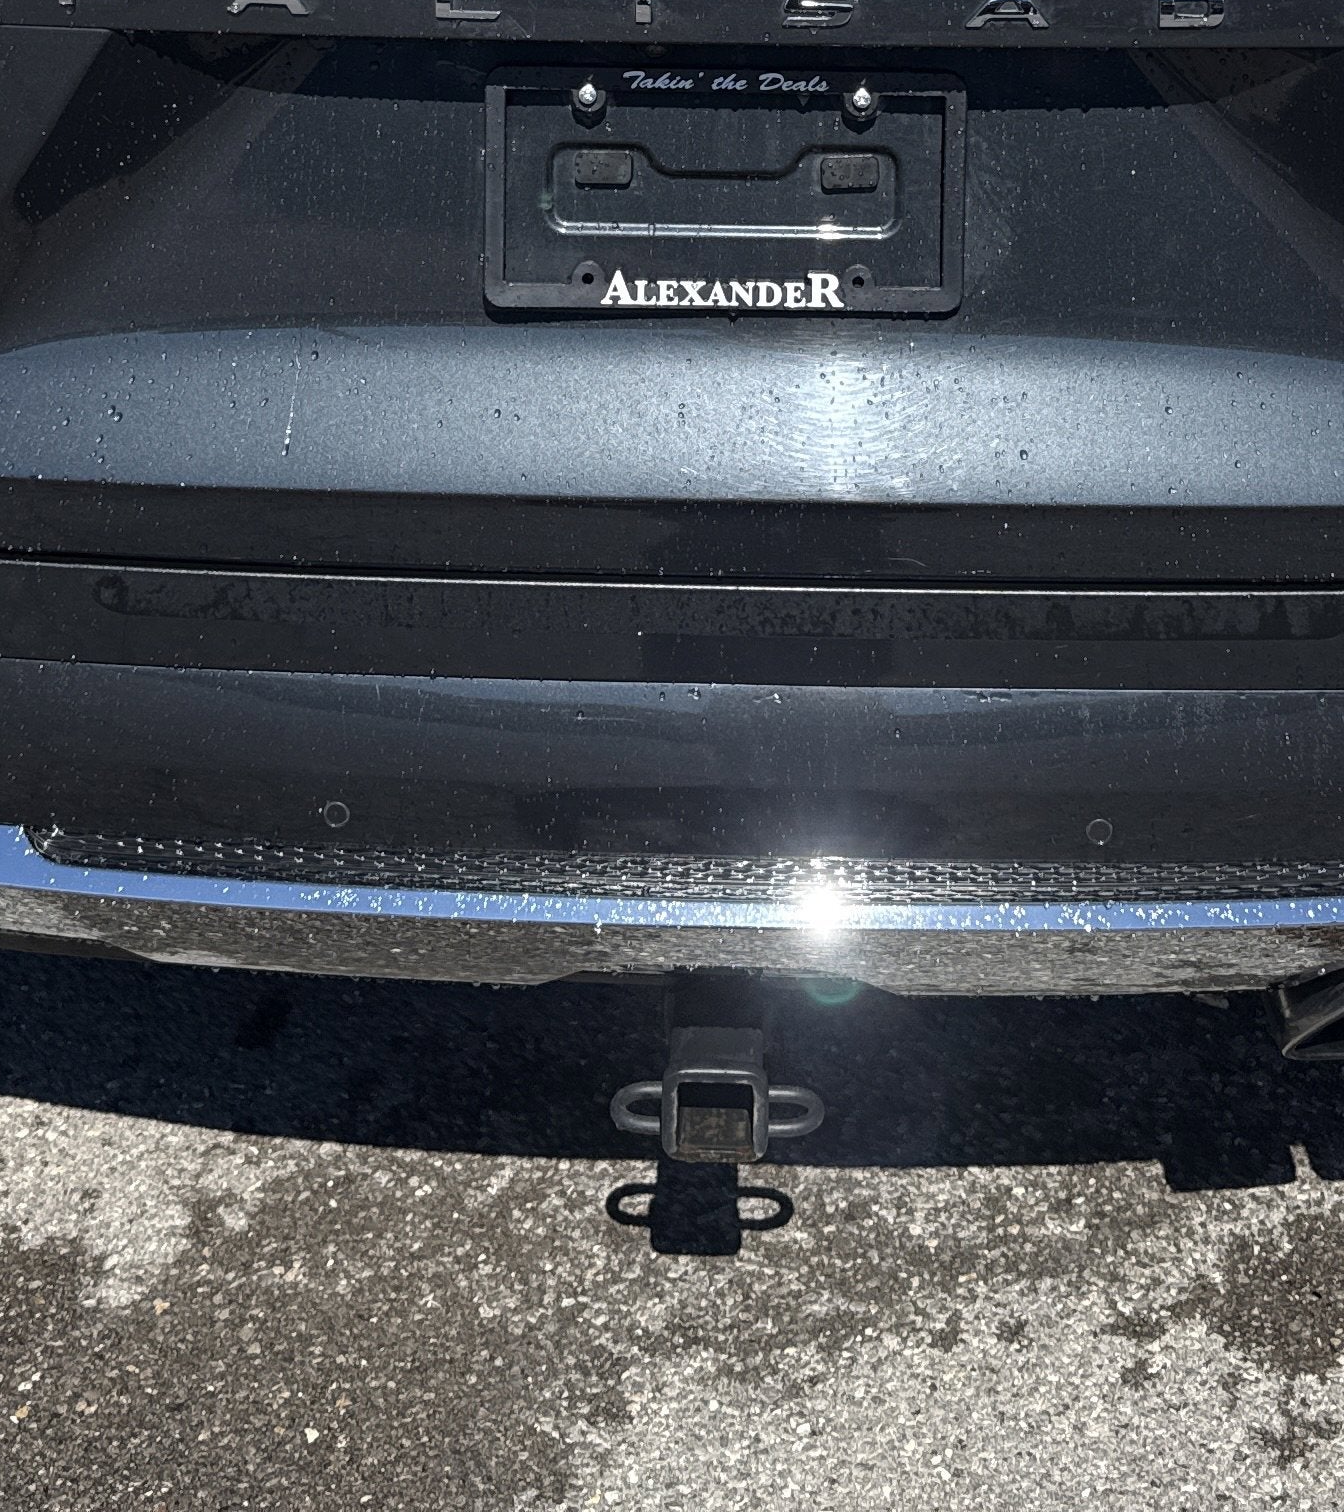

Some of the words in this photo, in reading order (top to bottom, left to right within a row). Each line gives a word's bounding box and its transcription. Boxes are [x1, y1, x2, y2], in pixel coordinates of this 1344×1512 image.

[622, 70, 705, 91] Takin'
[711, 72, 748, 92] the
[757, 74, 831, 94] Deals
[600, 269, 845, 308] ALEXANDER
